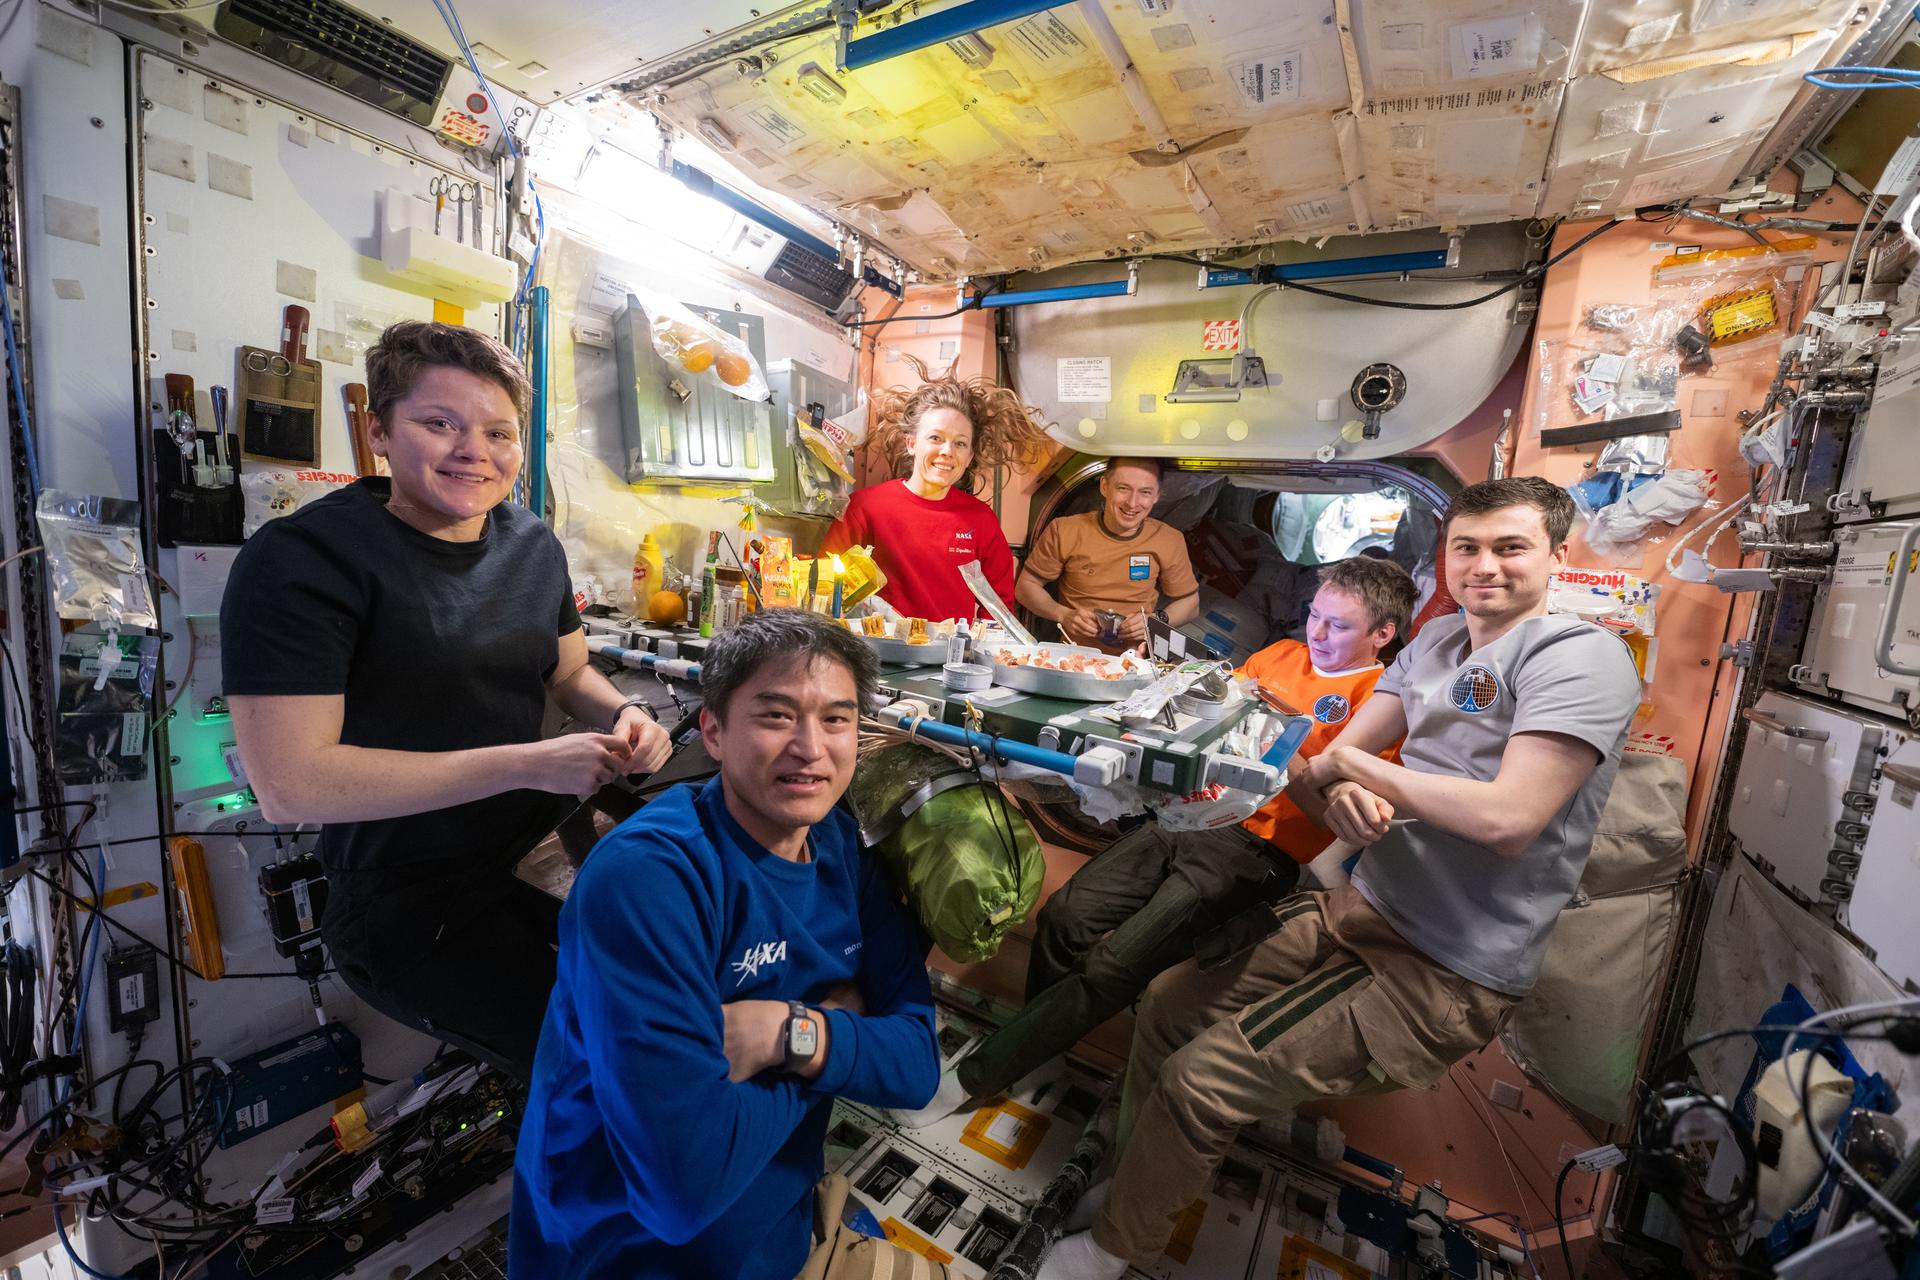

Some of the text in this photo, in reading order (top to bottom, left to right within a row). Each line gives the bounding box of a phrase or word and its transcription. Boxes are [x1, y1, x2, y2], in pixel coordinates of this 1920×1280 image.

[1490, 40, 1503, 60] TAPE
[1270, 68, 1280, 90] OFFICE
[1210, 328, 1233, 344] EXIT
[1558, 571, 1625, 590] HUGGIES
[1466, 703, 1475, 711] 73
[731, 940, 787, 987] JAXA
